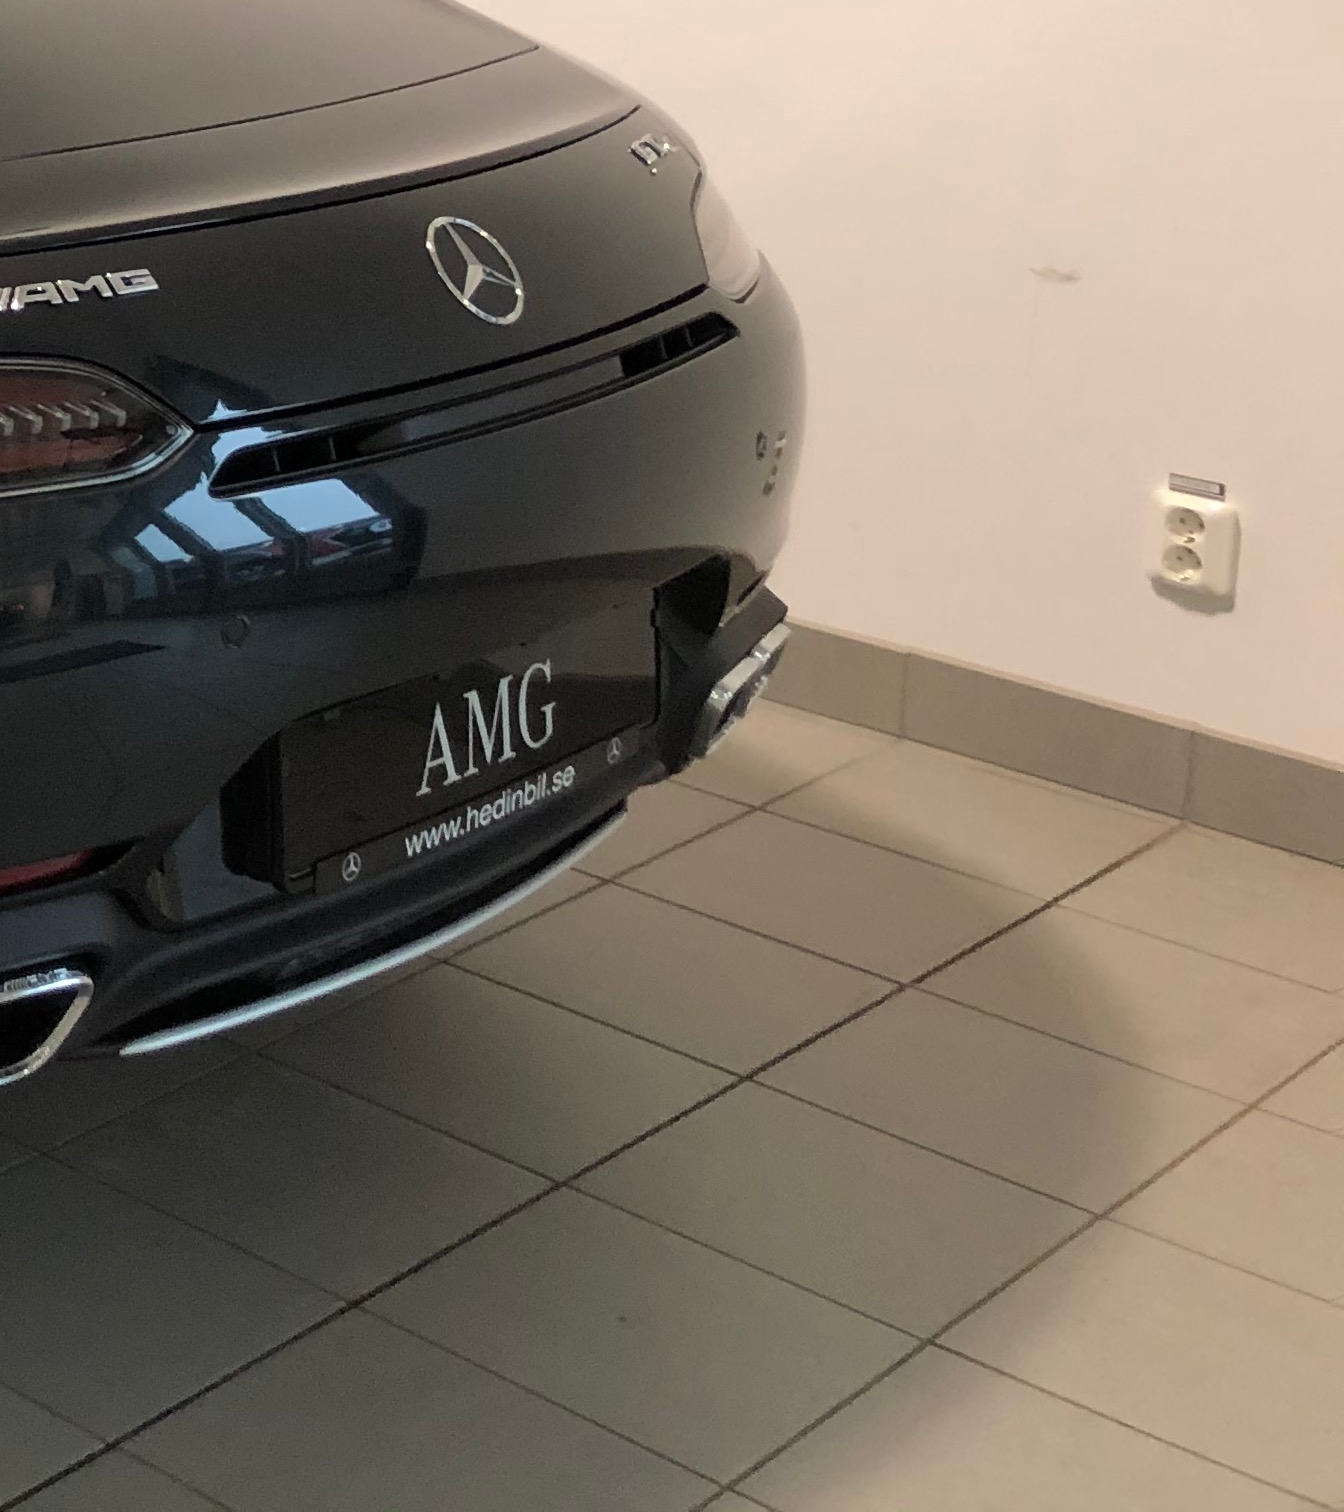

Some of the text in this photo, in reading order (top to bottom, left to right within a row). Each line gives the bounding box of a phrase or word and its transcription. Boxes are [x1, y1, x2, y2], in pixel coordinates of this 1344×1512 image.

[10, 268, 160, 311] AMG
[415, 658, 557, 797] AMG
[405, 765, 576, 858] www.hedinbil.se
